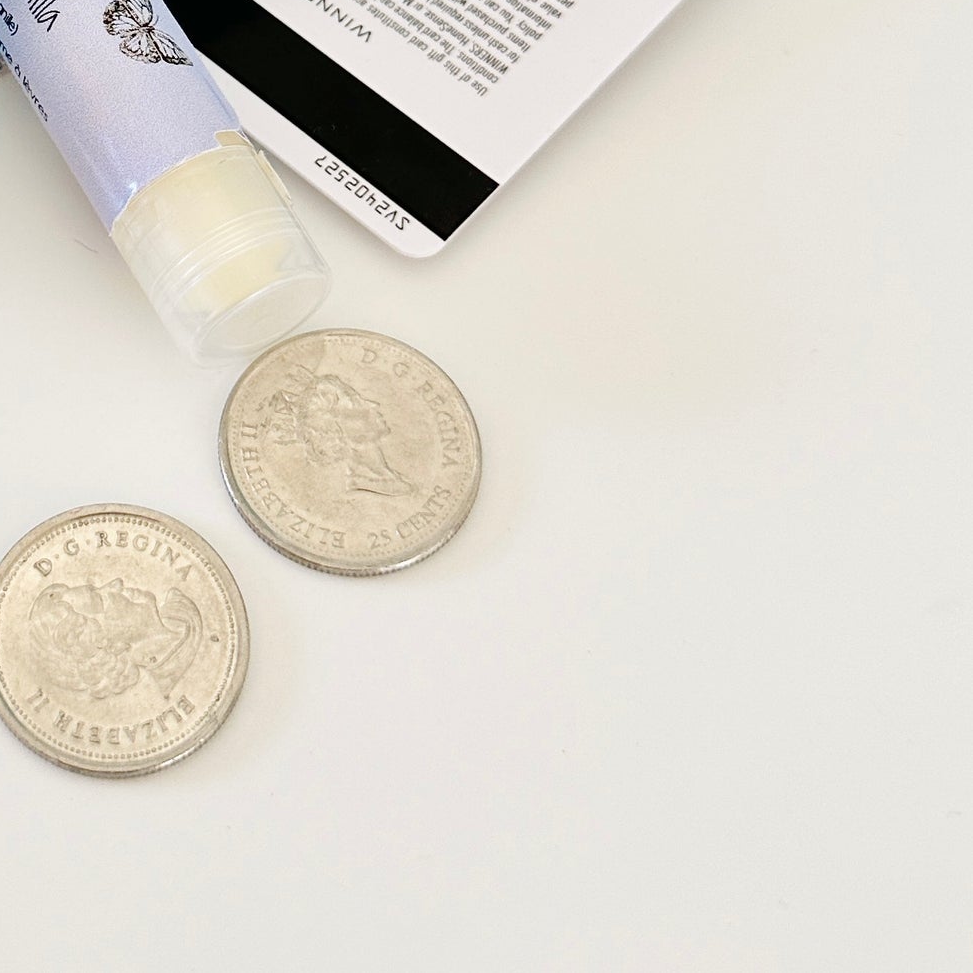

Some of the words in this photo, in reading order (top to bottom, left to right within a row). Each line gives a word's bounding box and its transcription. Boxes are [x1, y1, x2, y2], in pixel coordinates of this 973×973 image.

[412, 0, 424, 12] or
[495, 7, 516, 24] You
[536, 0, 563, 21] value
[363, 3, 411, 40] constitutes
[390, 5, 425, 32] balance
[463, 1, 509, 37] purchased
[419, 25, 442, 45] card
[460, 18, 490, 43] unless
[406, 34, 429, 54] card
[436, 37, 456, 55] The
[484, 36, 509, 56] cash
[503, 31, 531, 53] Items
[424, 46, 446, 65] gift
[503, 49, 520, 64] for
[440, 59, 461, 77] this
[456, 71, 472, 85] of
[467, 79, 489, 97] Use
[314, 154, 410, 231] SV2402527
[241, 422, 257, 440] II
[240, 446, 347, 549] ELIZABETH
[368, 529, 391, 550] 25
[395, 485, 452, 540] CENTS
[29, 688, 50, 712] II
[53, 695, 196, 744] ELIZABETH
